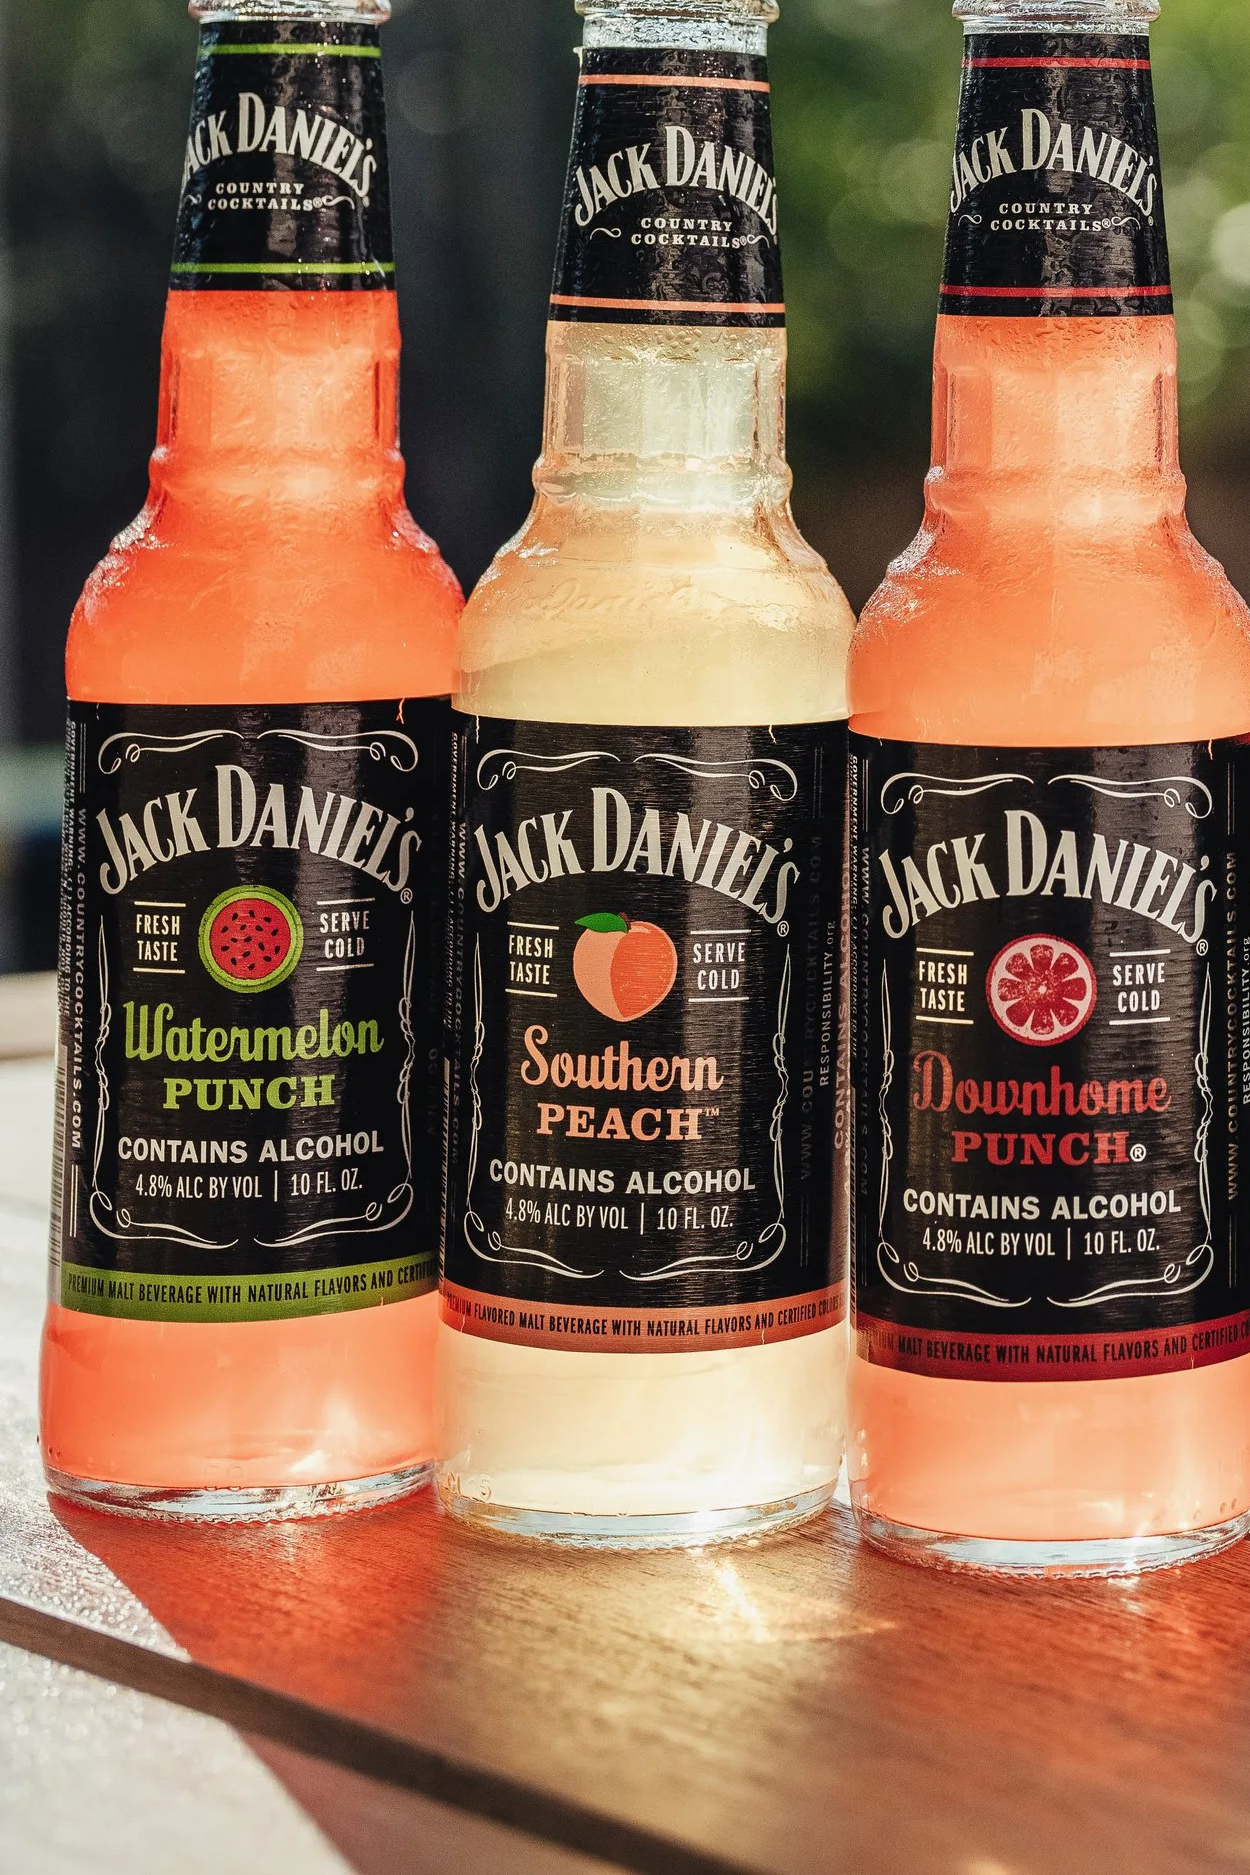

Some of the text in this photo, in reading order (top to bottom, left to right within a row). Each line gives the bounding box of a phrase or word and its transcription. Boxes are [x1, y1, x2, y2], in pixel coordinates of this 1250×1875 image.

[950, 126, 1017, 213] JACK
[216, 182, 304, 195] COUNTRY
[575, 143, 661, 226] JACK
[999, 202, 1093, 215] COUNTRY
[641, 217, 733, 232] COUNTRY
[96, 788, 211, 895] JACK
[474, 810, 584, 913] JACK
[879, 833, 1000, 939] JACK
[136, 914, 180, 935] FRESH
[320, 910, 370, 933] SERVE
[138, 940, 178, 962] TASTE
[325, 936, 365, 959] COLD
[509, 935, 553, 957] FRESH
[693, 942, 746, 964] SERVE
[509, 963, 550, 986] TASTE
[697, 969, 739, 990] COLD
[918, 960, 968, 987] FRESH
[1112, 961, 1165, 986] SERVE
[920, 988, 965, 1012] TASTE
[1117, 989, 1160, 1013] COLD
[123, 1000, 384, 1061] Watermelon
[520, 1024, 724, 1092] Southern
[163, 1075, 335, 1110] PUNCH
[912, 1050, 1172, 1117] Downhome
[118, 1130, 384, 1163] CONTAINS ALCOHOL
[135, 1174, 262, 1198] 4.8% ALC BY VOL
[291, 1168, 363, 1195] 10 FL. OZ.
[489, 1158, 756, 1195] CONTAINS ALCOHOL
[505, 1198, 628, 1229] 4.8% ALC BY VOL
[903, 1188, 1181, 1220] CONTAINS ALCOHOL
[657, 1206, 733, 1231] 10 FL. OZ.
[922, 1226, 1055, 1256] 4.8% ALC BY VOL
[1084, 1228, 1160, 1255] 10 FL. OZ.
[108, 1280, 134, 1300] MALT
[138, 1284, 202, 1304] BEVERAGE
[207, 1285, 242, 1303] WITH
[248, 1281, 309, 1301] NATURAL
[314, 1274, 368, 1297] FLAVORS
[371, 1270, 394, 1290] AND
